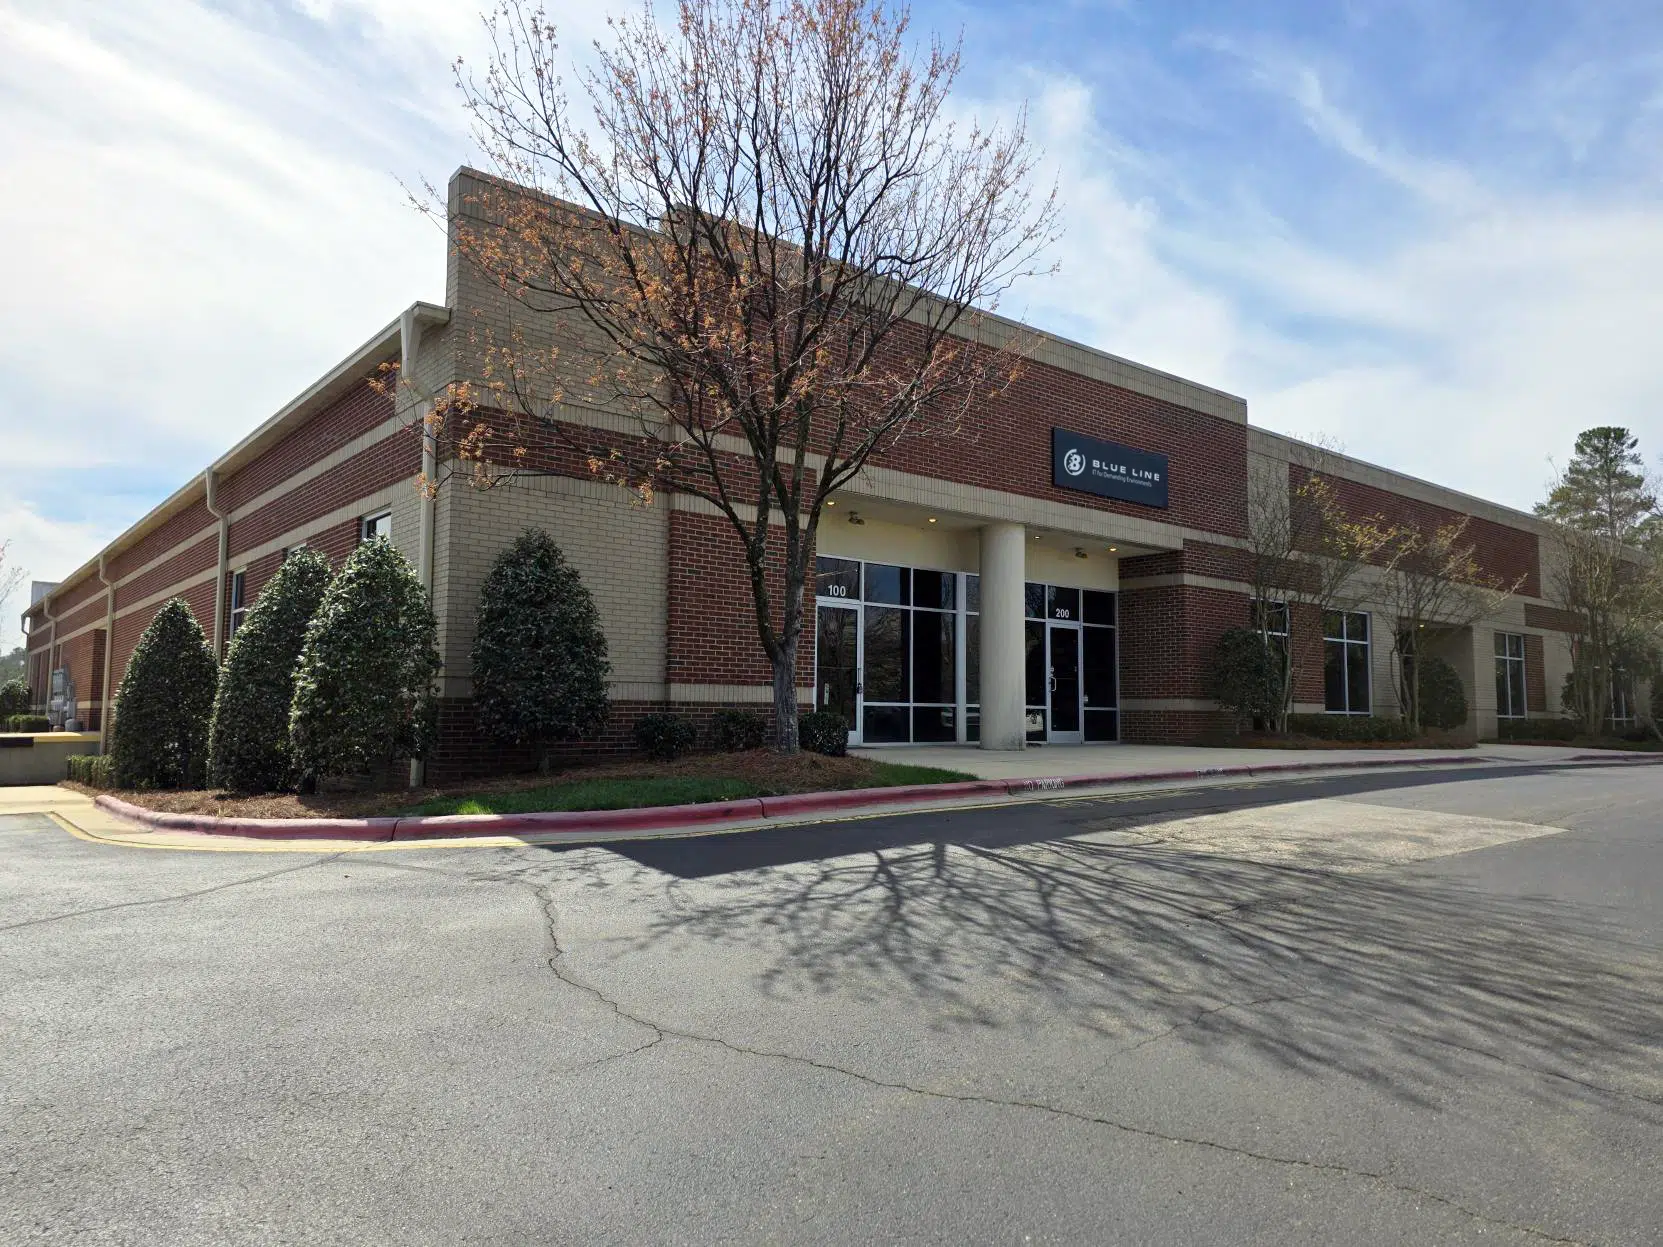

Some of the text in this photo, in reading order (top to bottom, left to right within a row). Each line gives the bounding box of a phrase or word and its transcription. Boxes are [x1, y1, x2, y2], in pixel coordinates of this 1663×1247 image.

[1092, 460, 1160, 482] BLUE LINE
[828, 584, 846, 597] 100
[1055, 608, 1070, 619] 200
